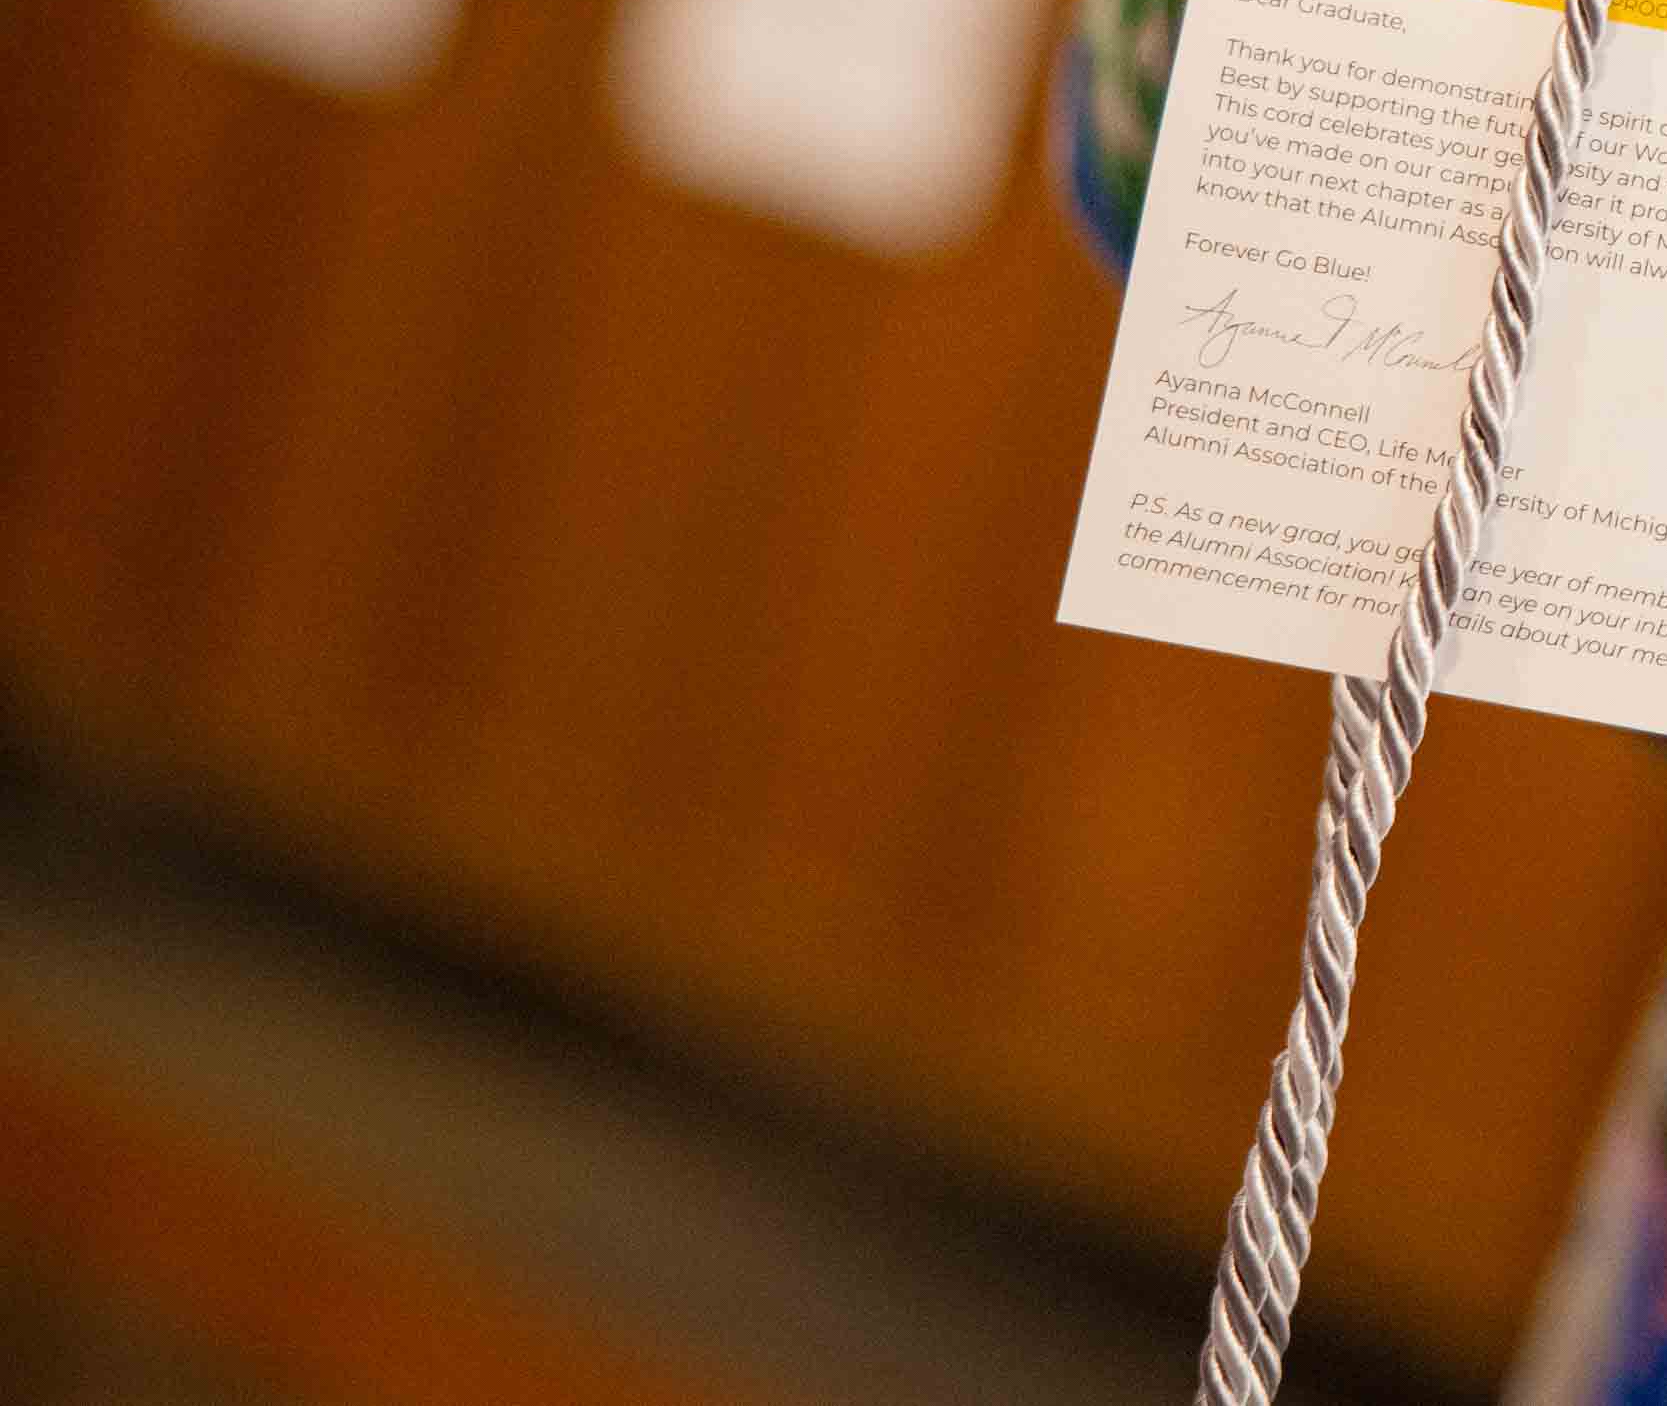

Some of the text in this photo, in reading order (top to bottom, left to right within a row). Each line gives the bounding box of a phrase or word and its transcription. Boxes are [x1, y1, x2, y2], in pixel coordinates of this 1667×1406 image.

[1219, 65, 1269, 91] Best
[1276, 75, 1304, 100] by
[1307, 86, 1435, 125] supporting
[1442, 108, 1480, 129] the
[1485, 114, 1528, 140] futu
[1572, 130, 1585, 150] f
[1588, 138, 1628, 156] our
[1227, 38, 1294, 66] Thank
[1296, 56, 1341, 75] you
[1347, 60, 1376, 81] for
[1381, 68, 1537, 112] demonstratin
[1598, 111, 1653, 134] spirit
[1203, 124, 1280, 150] you've
[1286, 139, 1352, 163] made
[1359, 153, 1388, 170] on
[1394, 159, 1433, 178] our
[1439, 168, 1512, 194] camp
[1609, 194, 1624, 214] it
[1215, 92, 1258, 117] This
[1262, 106, 1314, 127] cord
[1319, 116, 1434, 150] celebrates
[1435, 138, 1488, 160] your
[1493, 149, 1613, 186] gesity
[1616, 172, 1661, 192] and
[1196, 175, 1260, 203] know
[1264, 189, 1311, 214] that
[1317, 200, 1355, 221] the
[1359, 207, 1445, 239] Alumni
[1448, 223, 1578, 263] Assoion
[1586, 250, 1624, 270] will
[1202, 147, 1246, 172] into
[1249, 161, 1304, 183] your
[1309, 172, 1359, 194] next
[1365, 180, 1455, 210] chapter
[1459, 200, 1484, 217] as
[1490, 206, 1503, 221] a
[1550, 217, 1622, 246] versity
[1627, 229, 1653, 247] of
[1184, 231, 1373, 283] Forever Go Blue!
[1151, 396, 1524, 480] President and CEO, Life Mer
[1154, 369, 1370, 423] Ayanna McConnell
[1143, 425, 1229, 456] Alumni
[1232, 441, 1364, 480] Association
[1371, 467, 1396, 485] of
[1399, 472, 1437, 494] the
[1444, 479, 1559, 519] ersity
[1563, 503, 1589, 521] of
[1124, 521, 1162, 543] the
[1165, 529, 1251, 560] Alumni
[1254, 545, 1395, 584] Association!
[1461, 585, 1492, 604] an
[1497, 593, 1538, 613] eye
[1543, 602, 1572, 619] on
[1574, 609, 1630, 629] your
[1129, 492, 1169, 515] P.S.
[1173, 501, 1202, 521] As
[1207, 511, 1224, 525] a
[1228, 515, 1280, 536] new
[1280, 525, 1341, 551] grad,
[1343, 537, 1390, 556] you
[1393, 545, 1425, 569] ge
[1469, 557, 1506, 577] ree
[1507, 566, 1563, 587] year
[1567, 575, 1594, 593] of
[1117, 552, 1312, 600] commencement
[1315, 584, 1348, 606] for
[1351, 595, 1400, 616] mor
[1447, 610, 1495, 634] tails
[1499, 620, 1570, 648] about
[1571, 636, 1628, 658] your
